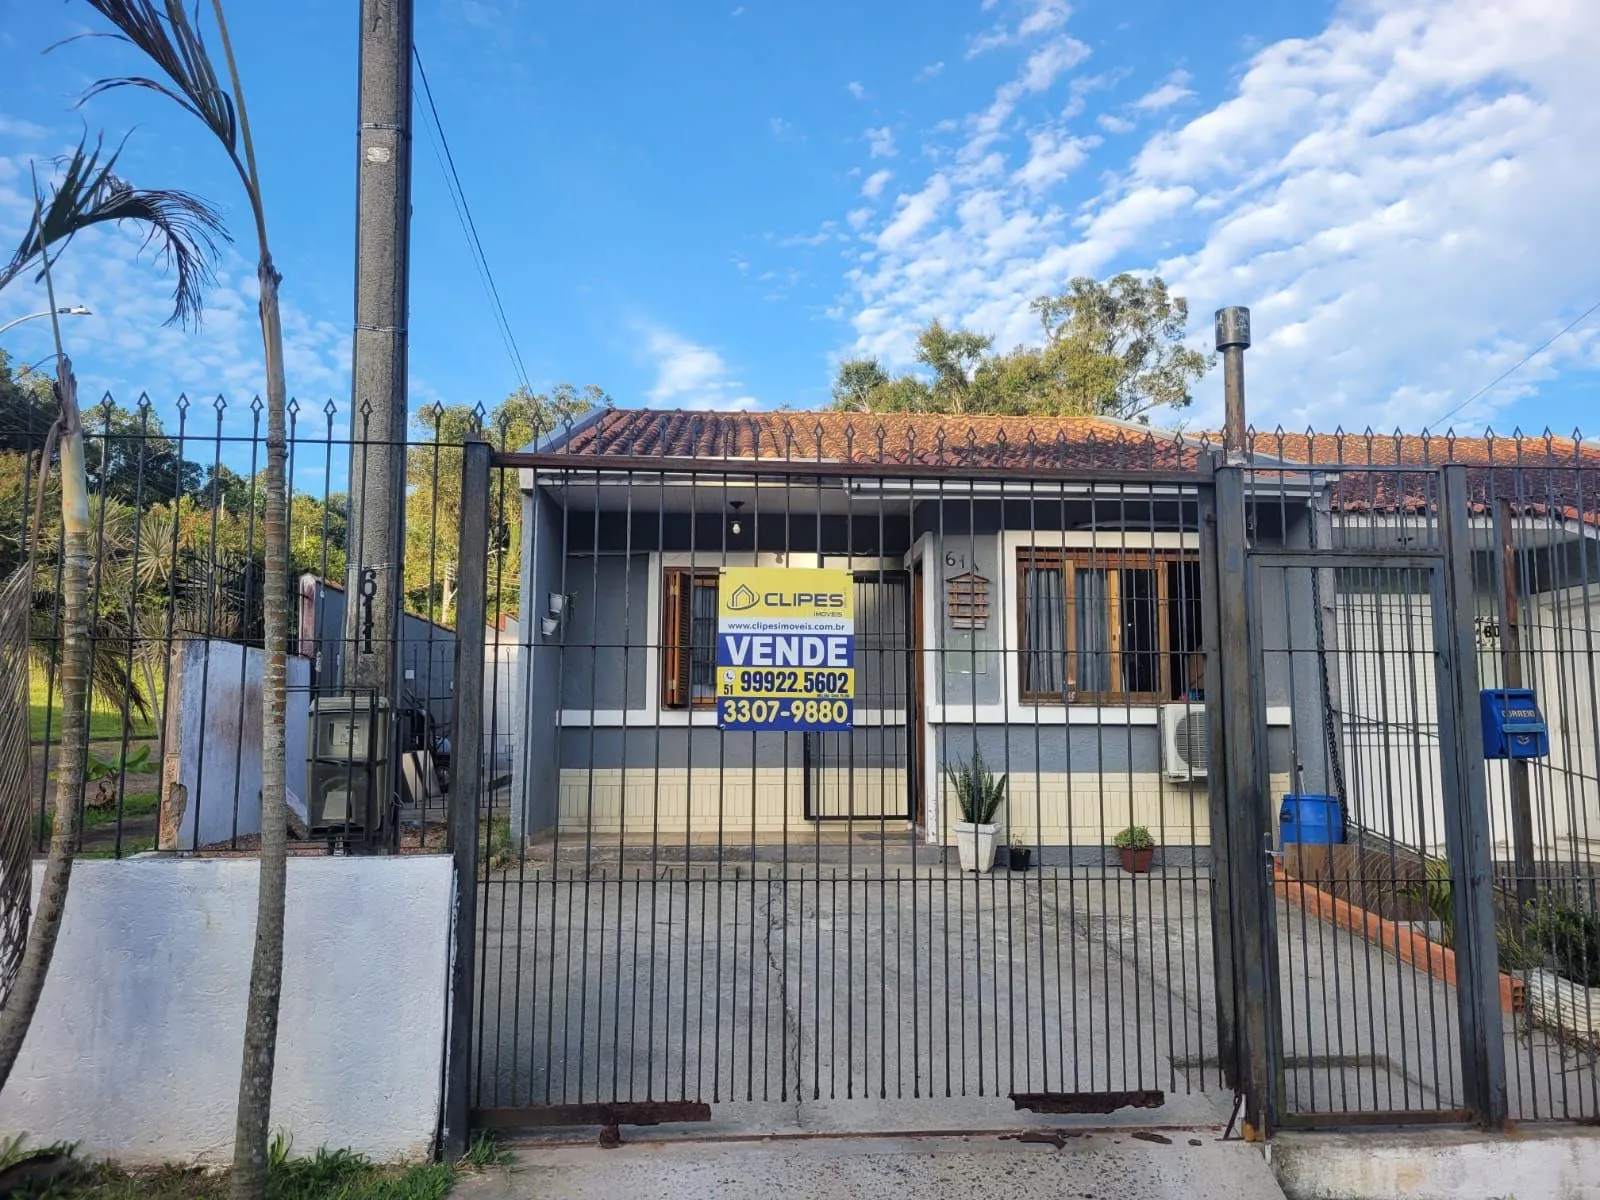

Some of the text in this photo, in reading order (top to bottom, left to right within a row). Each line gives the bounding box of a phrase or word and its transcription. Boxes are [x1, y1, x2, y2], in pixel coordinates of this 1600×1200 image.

[358, 569, 377, 654] 611
[765, 593, 843, 607] CLIPES
[728, 621, 845, 631] www.clipesimoveis.com.br
[726, 636, 848, 667] VENDE
[724, 671, 848, 695] 51 99922.5602
[724, 700, 848, 724] 3307-9880
